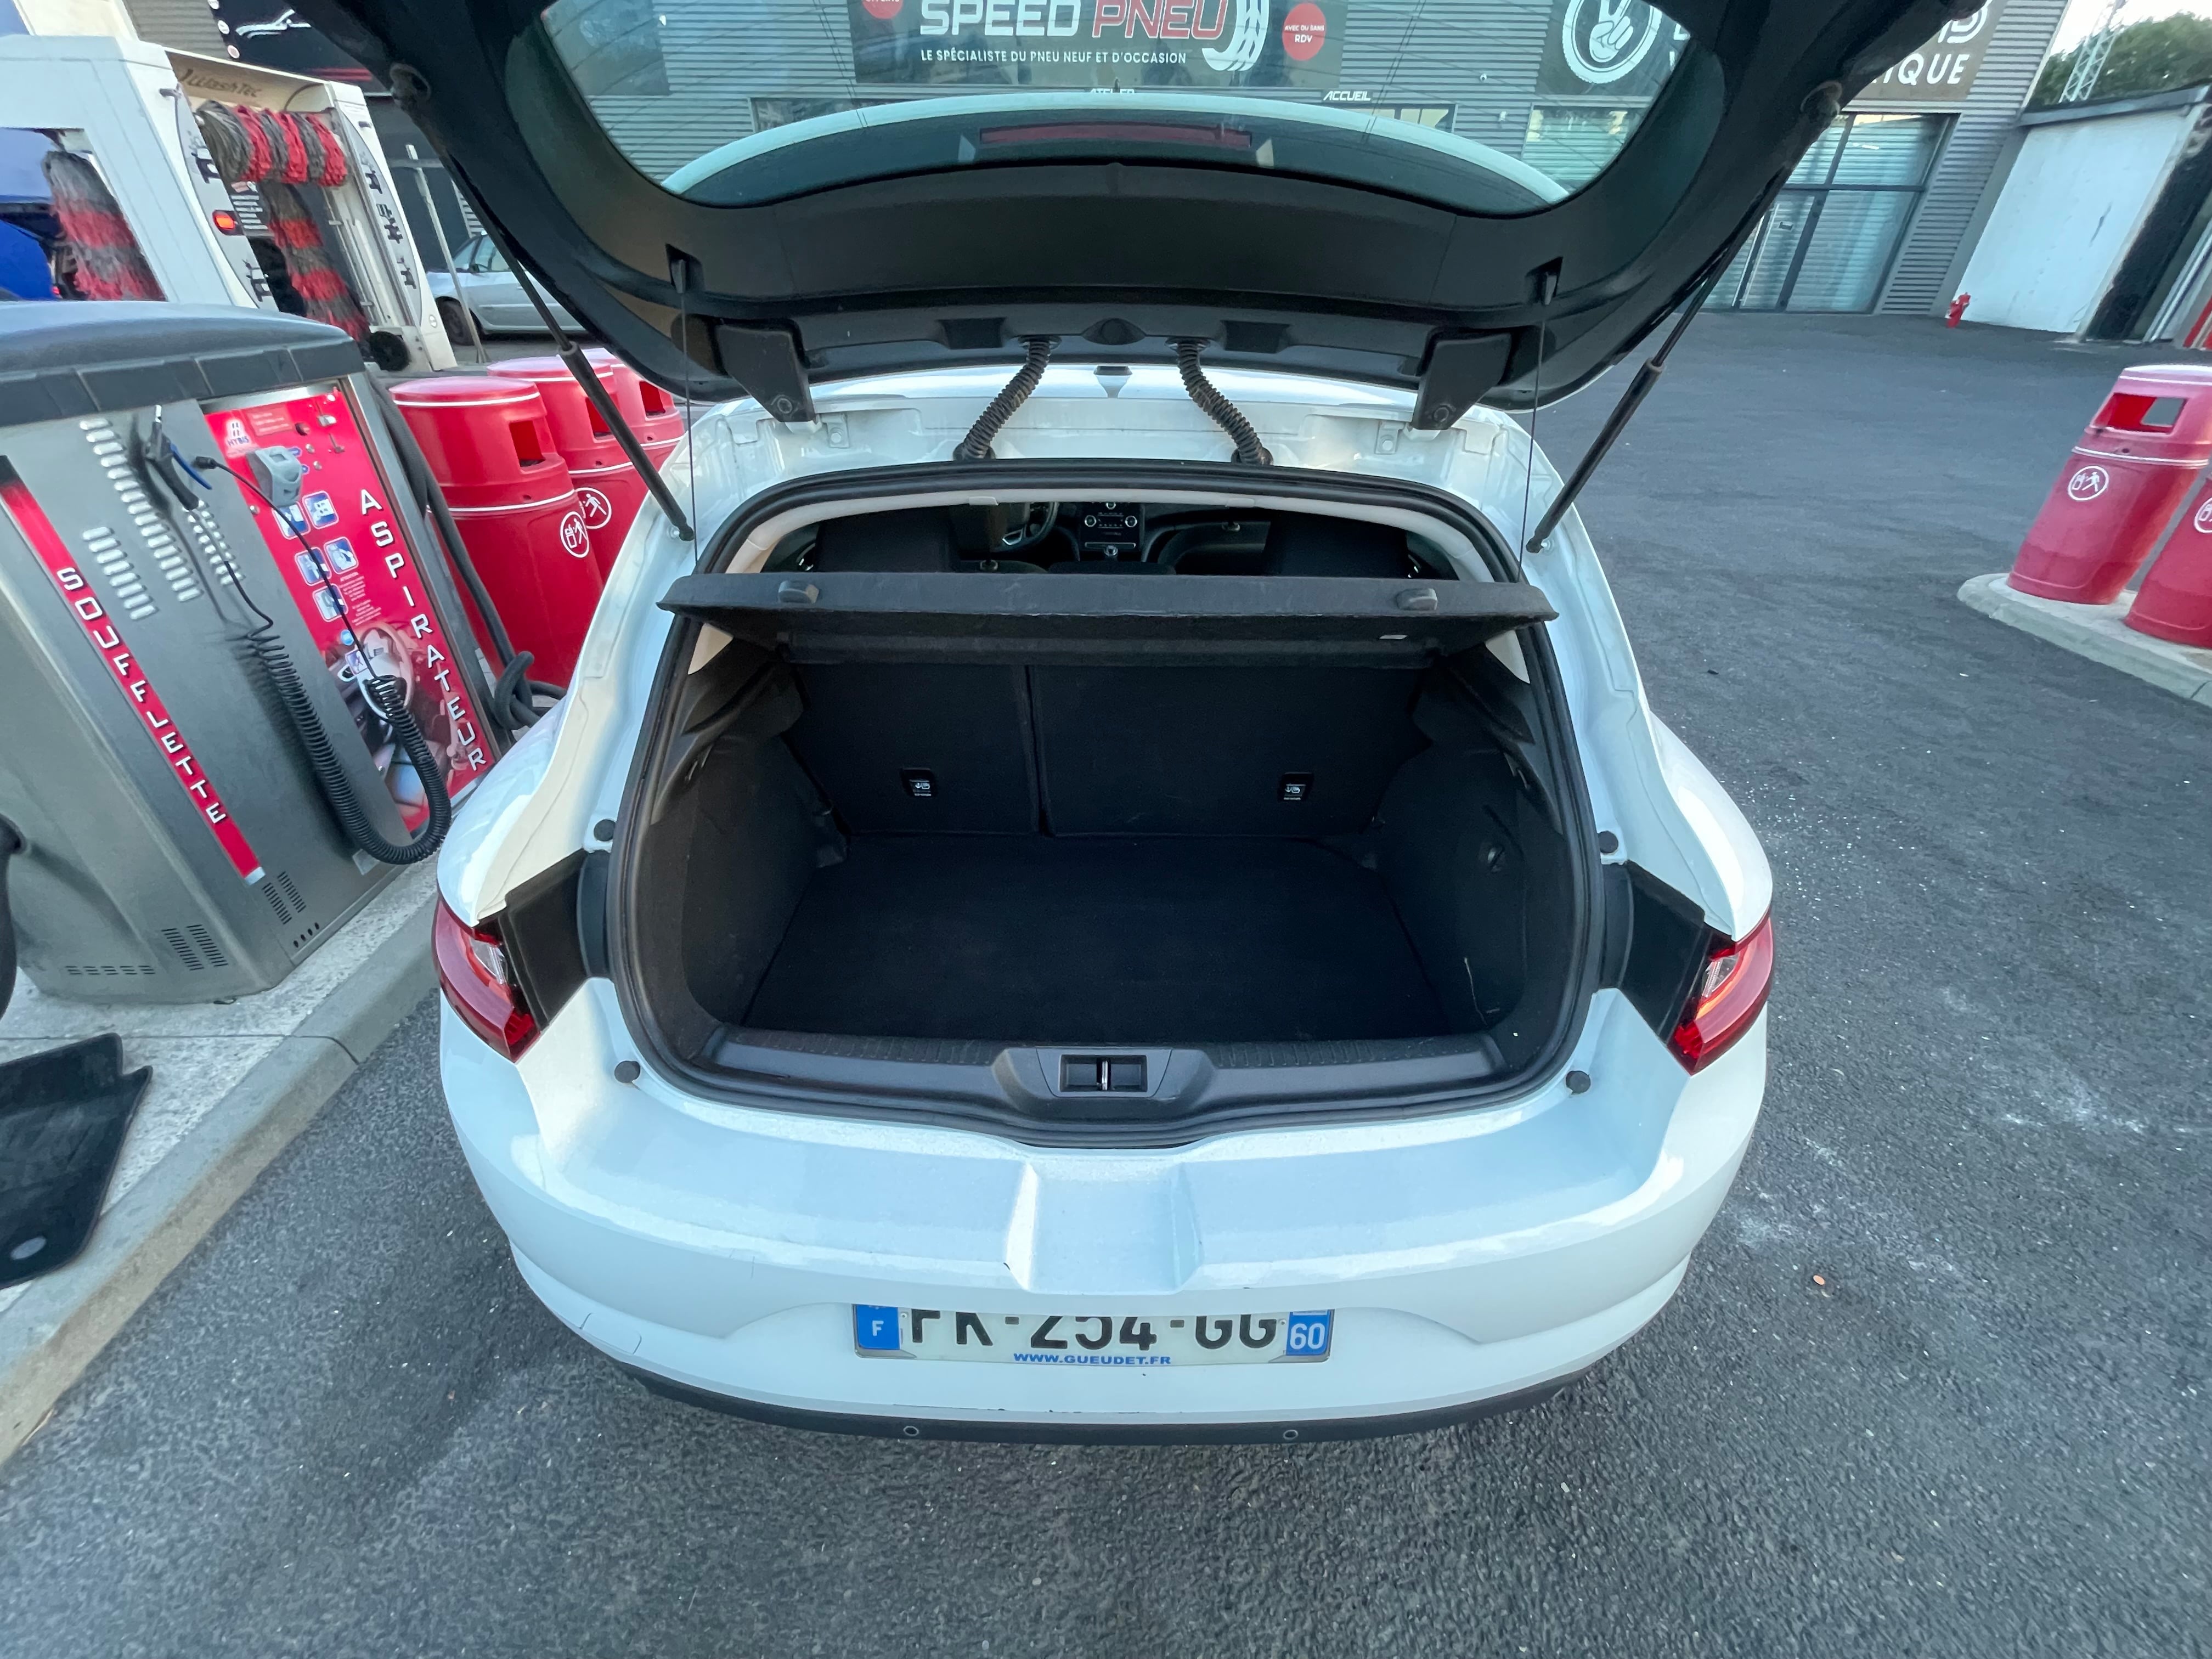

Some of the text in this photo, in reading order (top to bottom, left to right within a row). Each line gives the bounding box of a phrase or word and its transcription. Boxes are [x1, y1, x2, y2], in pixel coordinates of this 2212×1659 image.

[920, 0, 1229, 40] SPEED PNEU
[1295, 34, 1313, 43] RDV
[921, 47, 1186, 64] LE SPÉCIALISTE DU PNEU NEUF ET D'OCCASION
[1871, 53, 1970, 85] IQUE
[1323, 90, 1371, 101] ACCUEIL
[360, 489, 487, 771] ASPIRATEUR
[57, 567, 226, 824] SOUFFLETTE
[872, 1320, 884, 1336] F
[1290, 1323, 1325, 1350] 60
[1013, 1353, 1171, 1365] WWW.GUEUDET.FR
